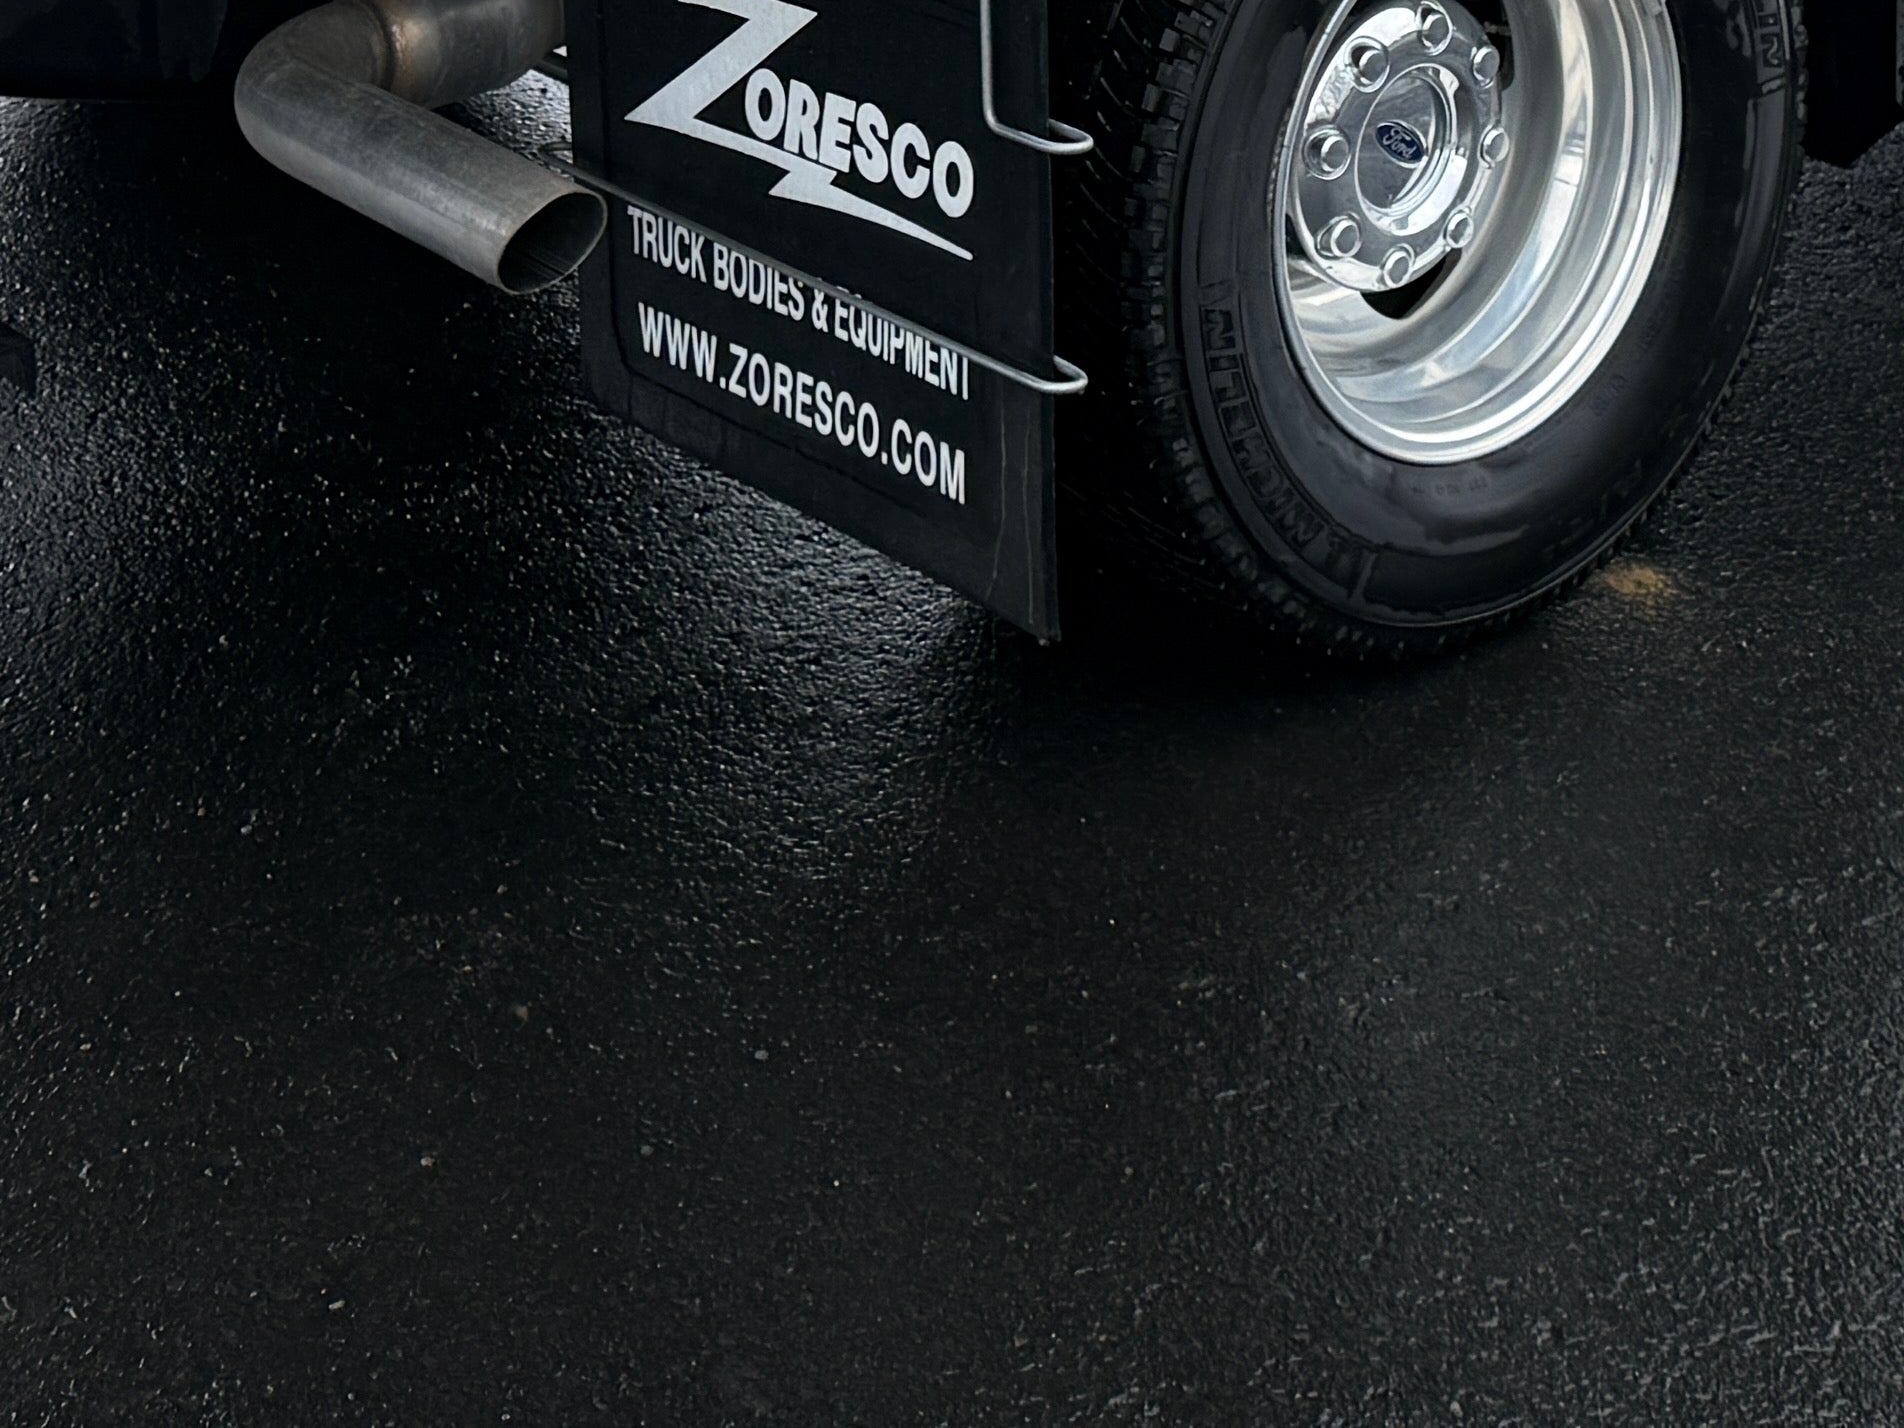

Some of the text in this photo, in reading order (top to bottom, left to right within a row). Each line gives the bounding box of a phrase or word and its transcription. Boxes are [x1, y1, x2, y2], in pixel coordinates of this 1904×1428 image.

[1382, 127, 1418, 159] Ford
[627, 204, 708, 283] TRUCK
[712, 242, 805, 321] BODIES
[810, 278, 830, 333] &
[637, 301, 966, 505] WWW.ZORESCO.COM
